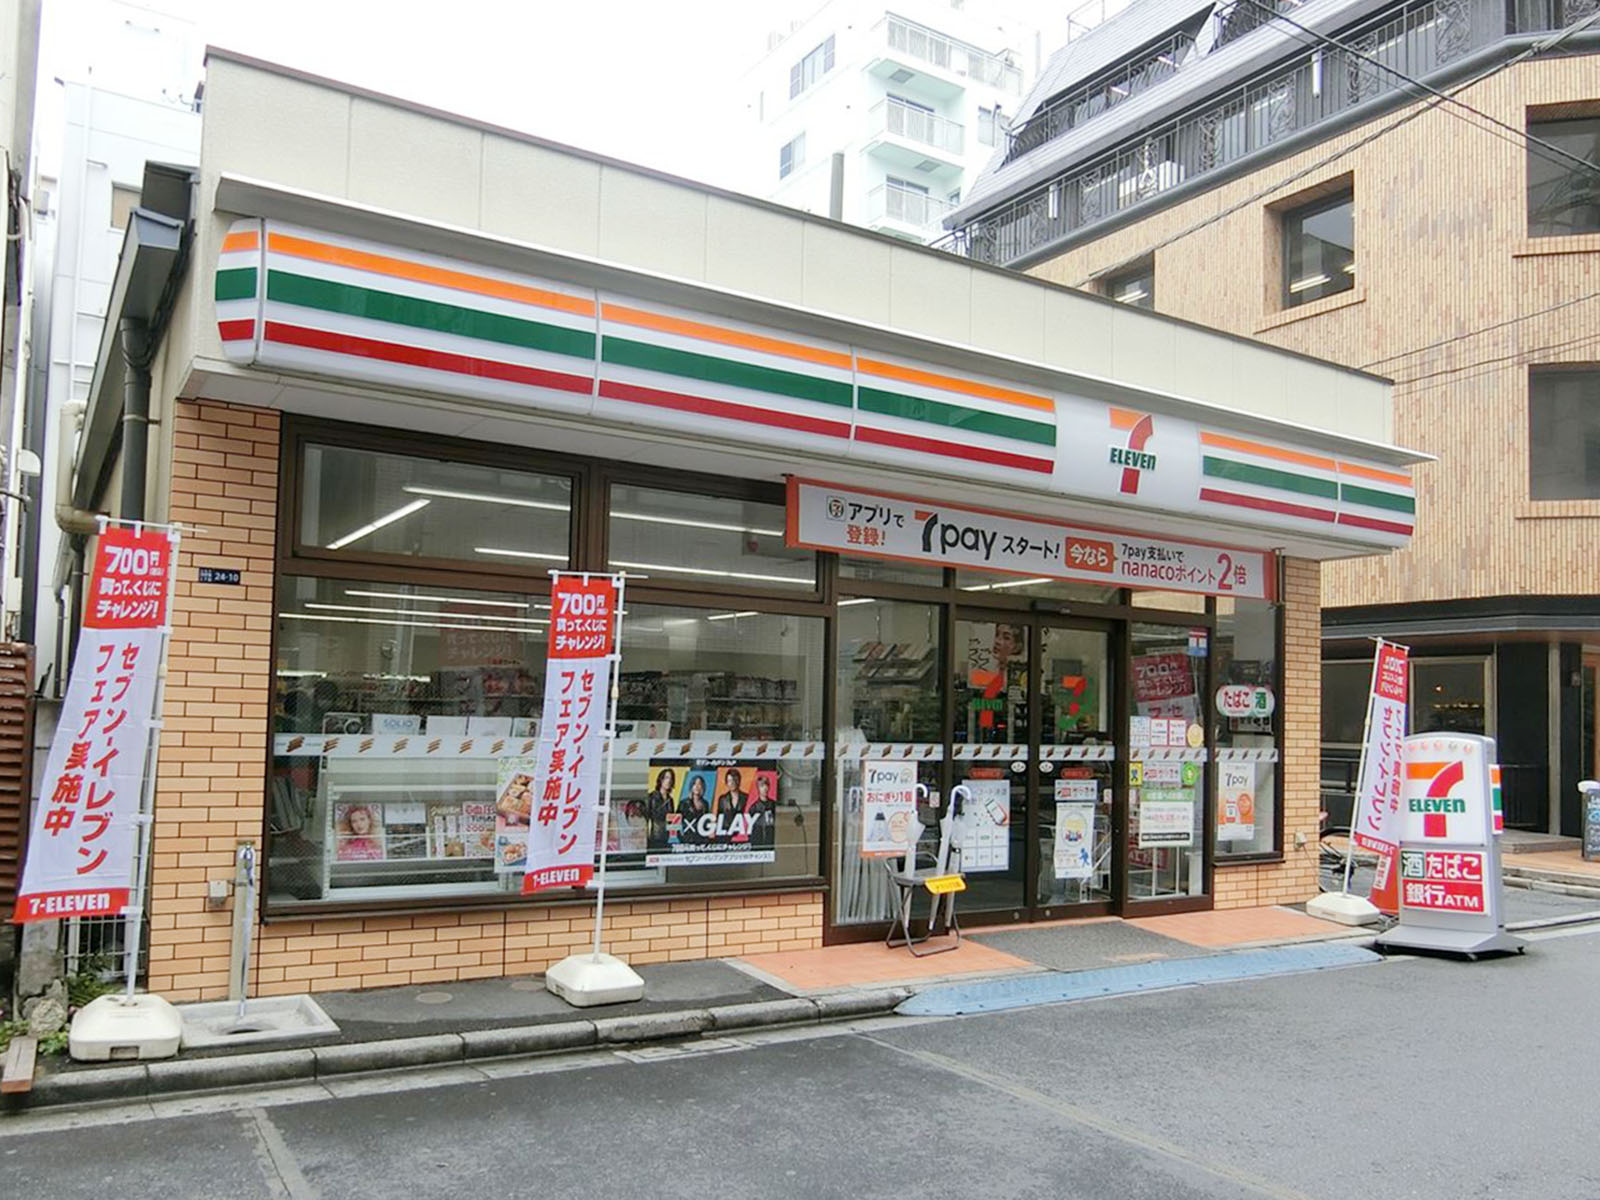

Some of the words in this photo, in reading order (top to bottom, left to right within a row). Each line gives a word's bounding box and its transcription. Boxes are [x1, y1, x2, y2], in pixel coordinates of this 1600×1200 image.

[848, 502, 904, 528] アプリで
[846, 524, 886, 546] 登録!
[914, 509, 997, 560] 7pay
[1069, 545, 1109, 567] 今なら
[1121, 561, 1216, 585] nanacoポイント
[1223, 691, 1250, 709] たばこ
[44, 644, 115, 837] フェア実施中
[537, 671, 575, 827] フェア実施中
[868, 768, 899, 784] 7pay
[697, 812, 760, 837] GLAY
[1403, 853, 1424, 879] 酒
[1426, 853, 1481, 880] たばこ
[1406, 882, 1479, 908] 銀行ATM
